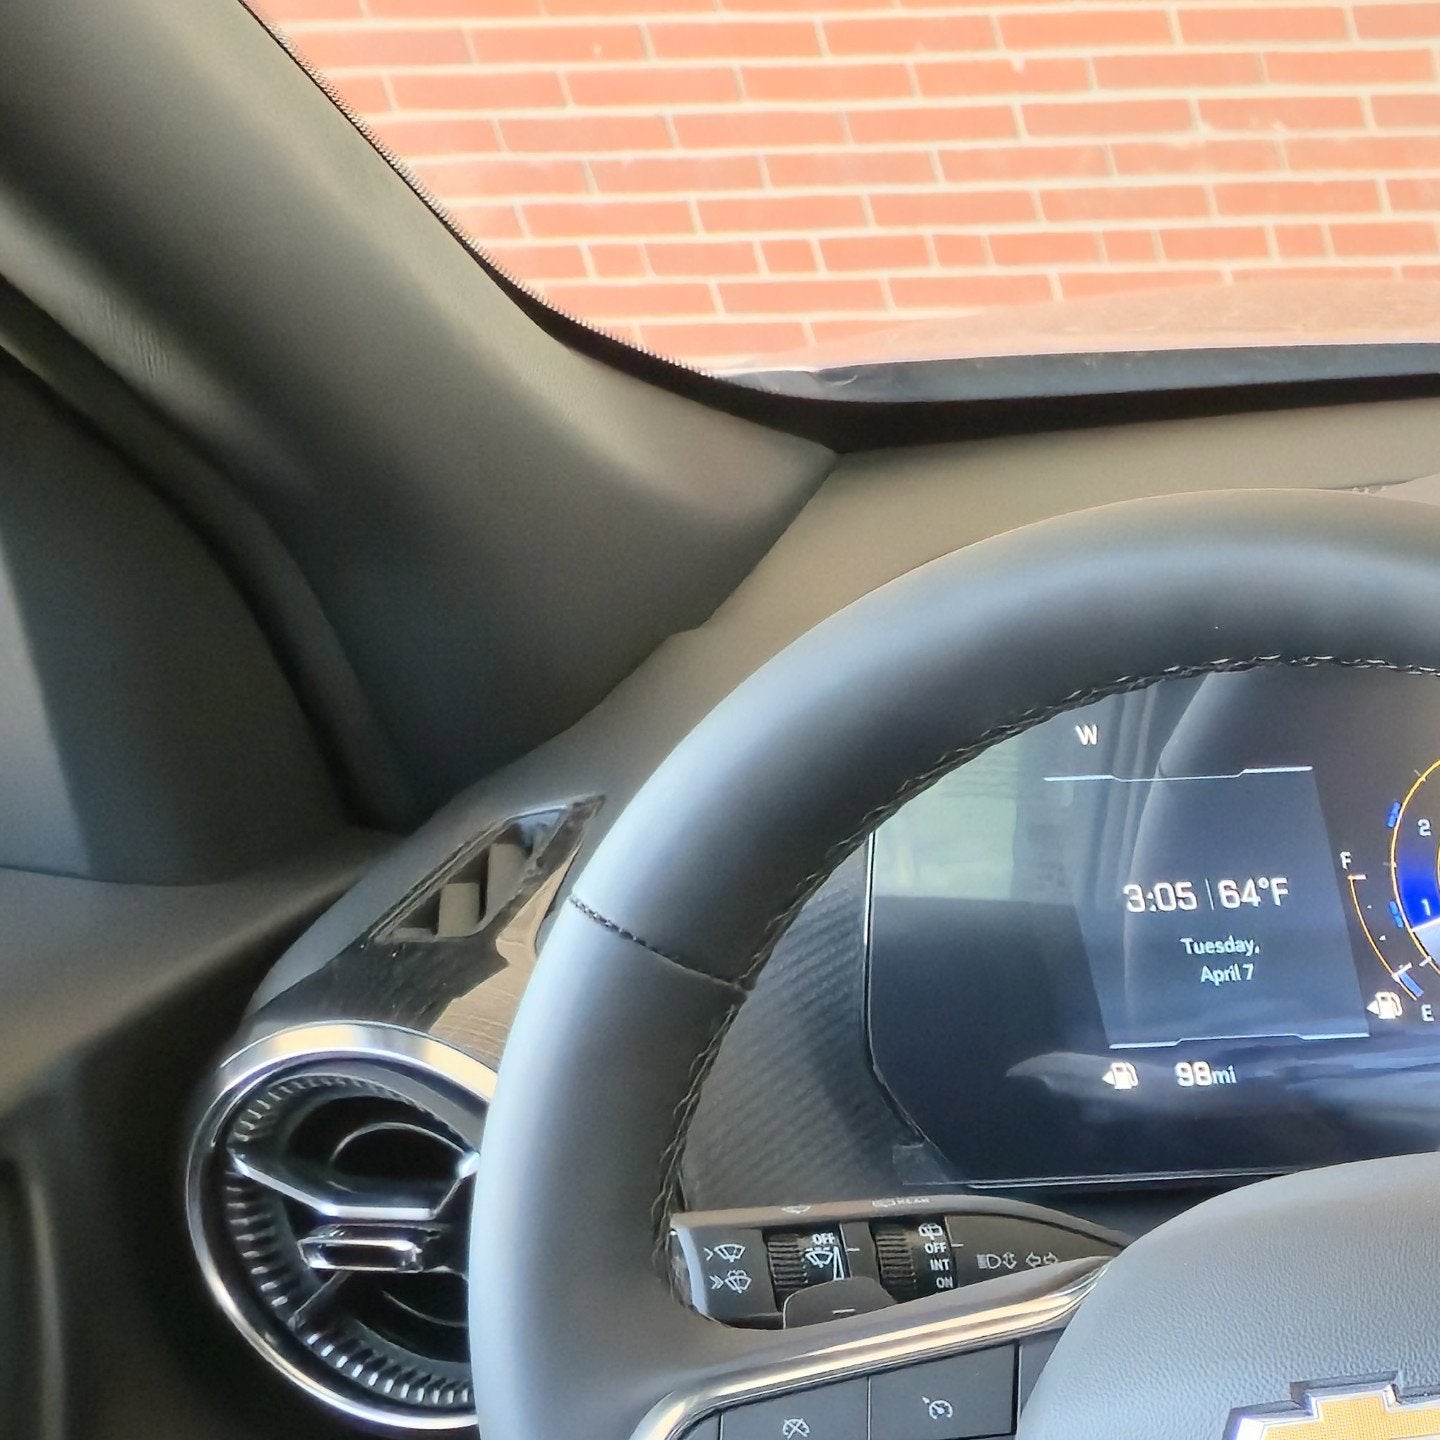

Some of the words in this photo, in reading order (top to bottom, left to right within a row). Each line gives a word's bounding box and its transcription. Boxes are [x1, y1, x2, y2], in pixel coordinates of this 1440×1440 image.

[1075, 725, 1098, 745] W
[1419, 820, 1431, 836] 2
[1340, 852, 1352, 869] F
[1123, 881, 1197, 912] 3:05
[1218, 877, 1288, 908] 64°F
[1180, 935, 1260, 956] Tuesday,
[1200, 965, 1242, 985] April
[1243, 964, 1254, 980] 7
[1421, 1005, 1434, 1021] E
[812, 1232, 835, 1244] OFF
[925, 1242, 947, 1254] OFF
[930, 1259, 949, 1271] INT
[936, 1276, 953, 1289] ON
